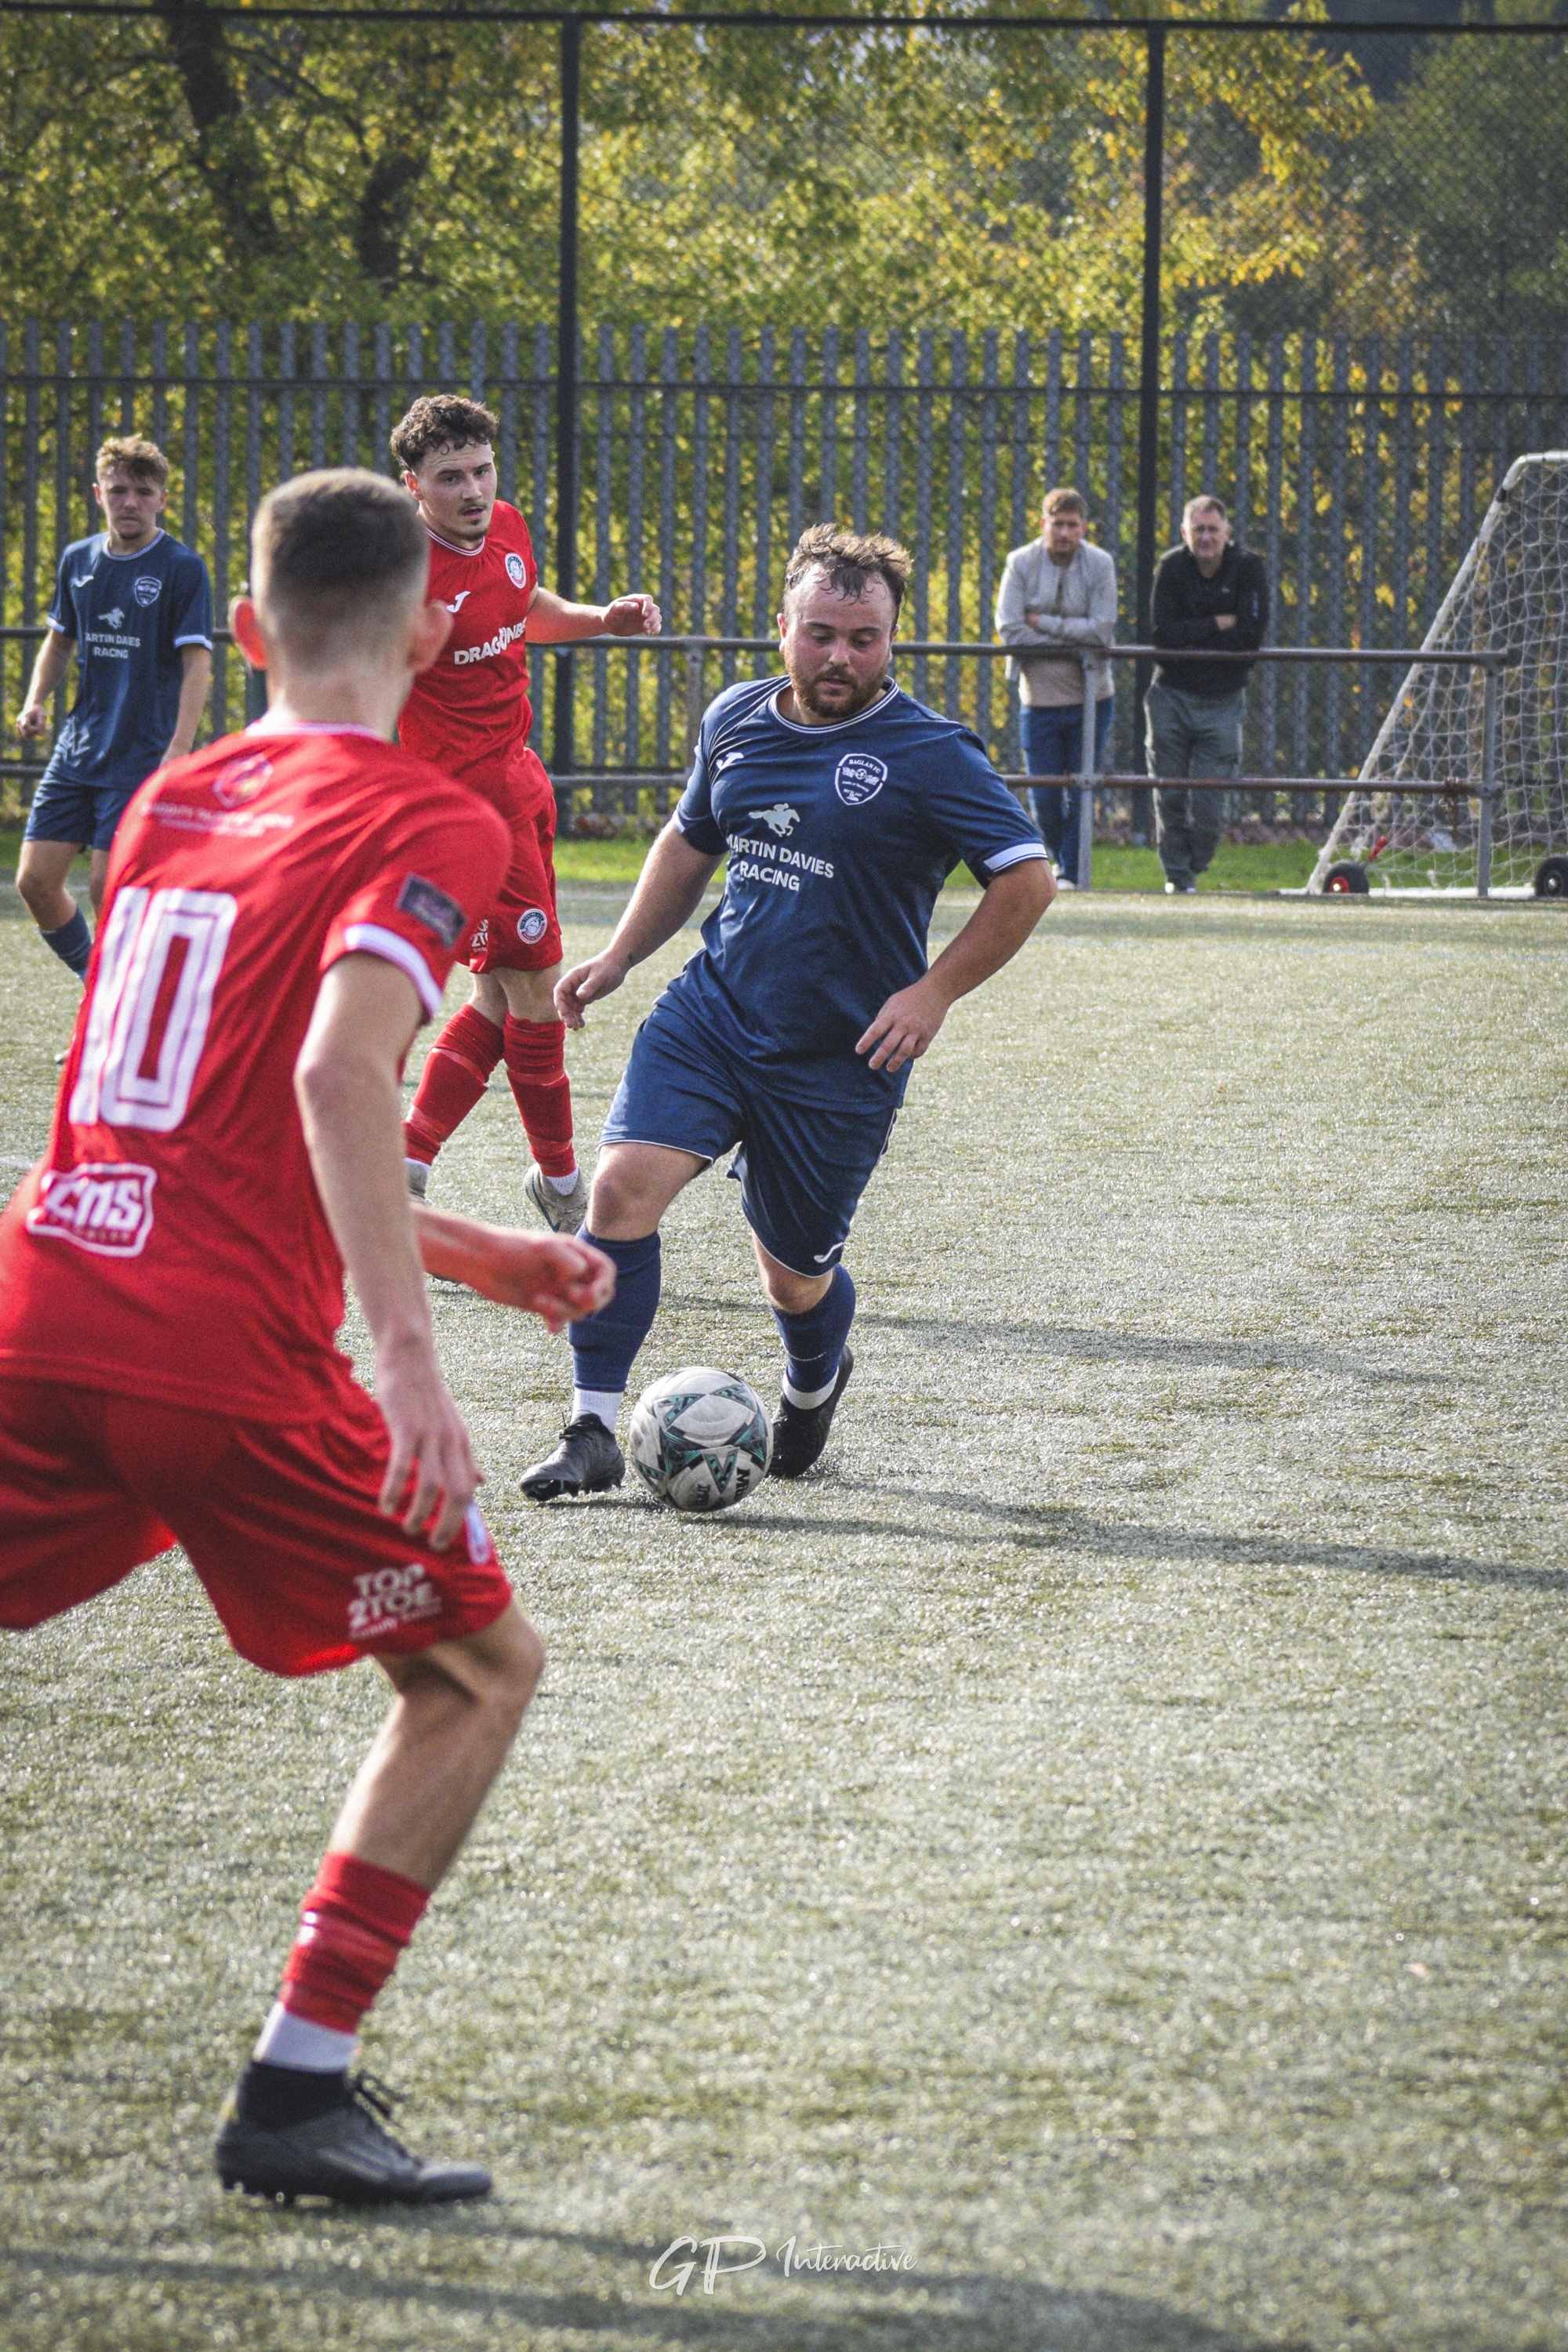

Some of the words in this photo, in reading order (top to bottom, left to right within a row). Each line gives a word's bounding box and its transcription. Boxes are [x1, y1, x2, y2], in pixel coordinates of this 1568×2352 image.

[85, 632, 114, 643] ARTIN
[848, 759, 874, 769] BAGLAN
[740, 860, 800, 891] RACING
[779, 847, 834, 878] DAVIES
[68, 886, 238, 1133] 10
